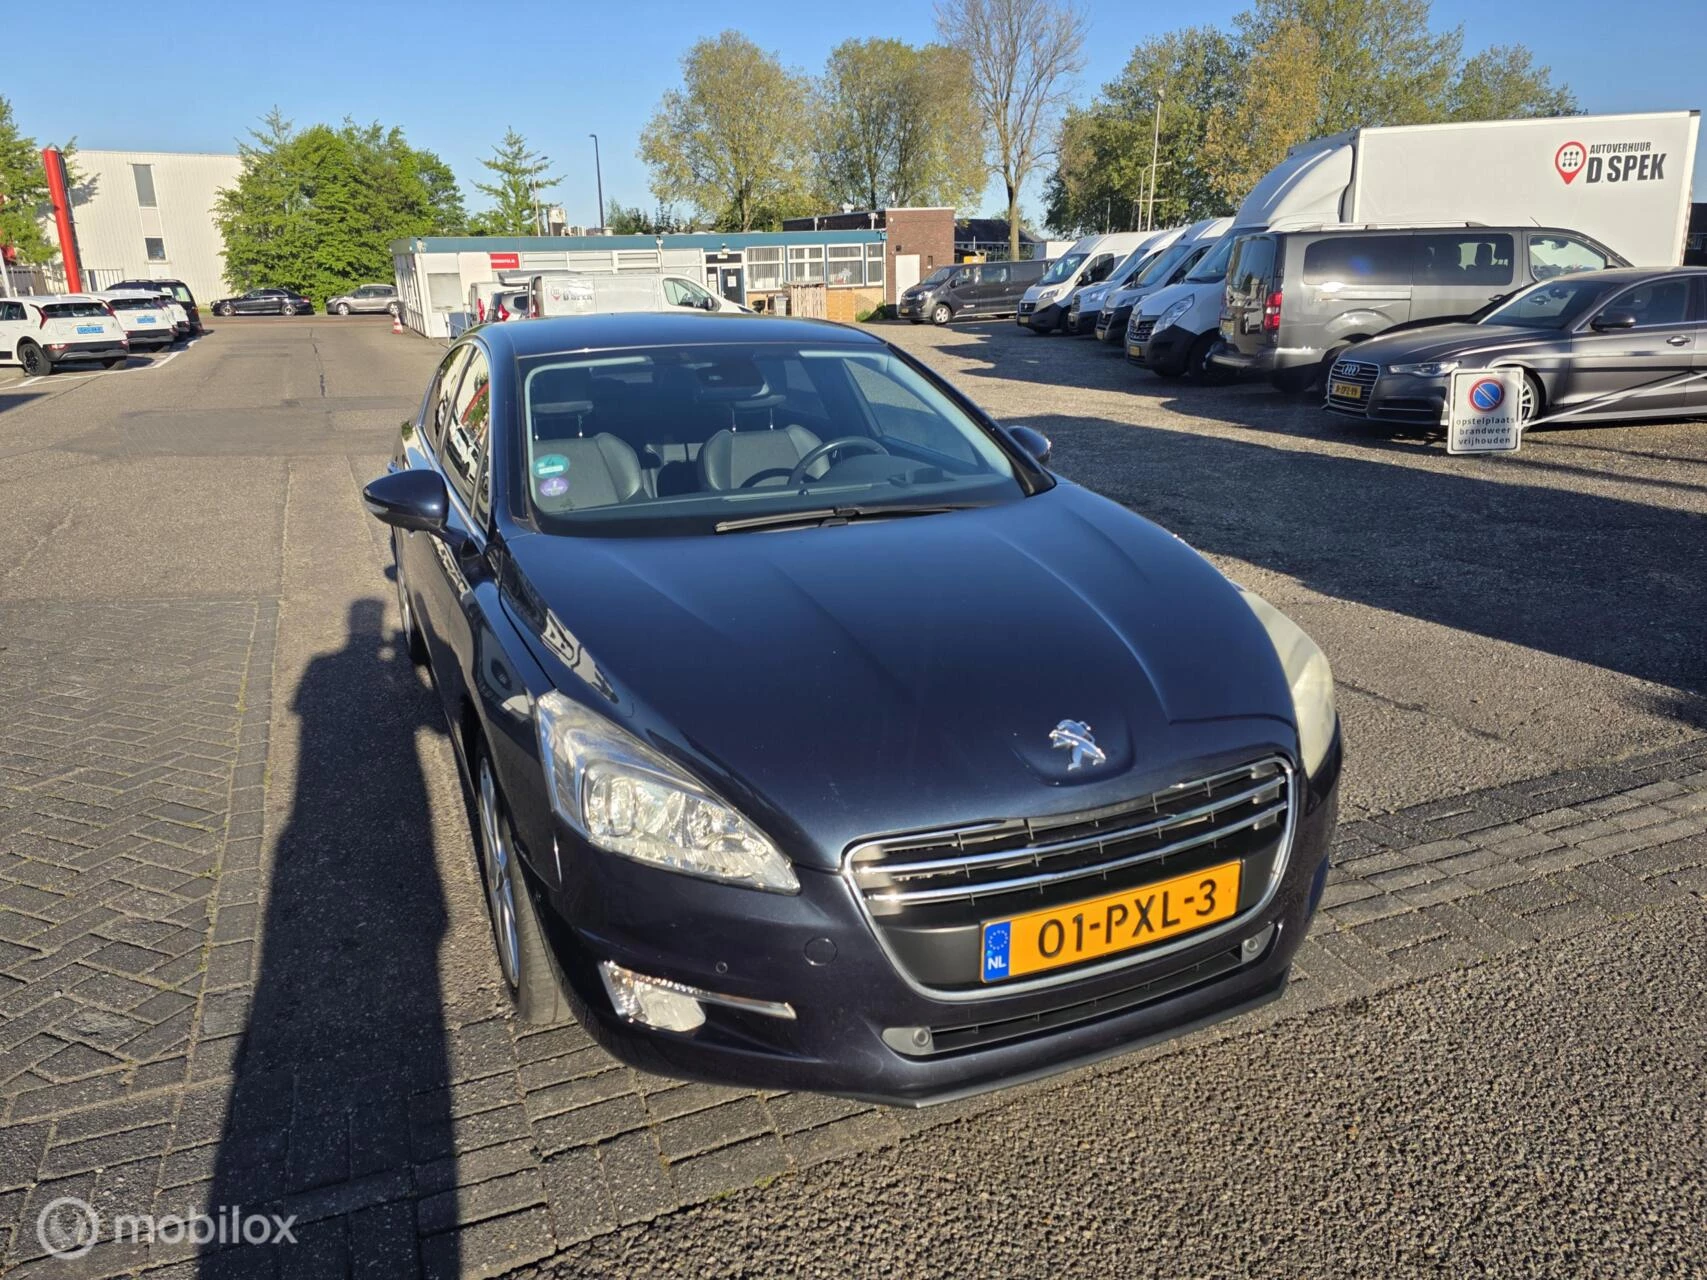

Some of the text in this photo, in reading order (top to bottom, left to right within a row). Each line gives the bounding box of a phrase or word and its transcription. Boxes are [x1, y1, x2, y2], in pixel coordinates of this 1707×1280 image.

[1589, 142, 1652, 154] AUTOVERHUUR
[1606, 153, 1667, 183] SPEK
[1456, 416, 1515, 426] opstelplaats
[1459, 427, 1511, 435] brandweer
[1457, 437, 1511, 447] vrijhouden
[1038, 879, 1217, 959] 01-PXL-3
[987, 956, 1007, 970] NL
